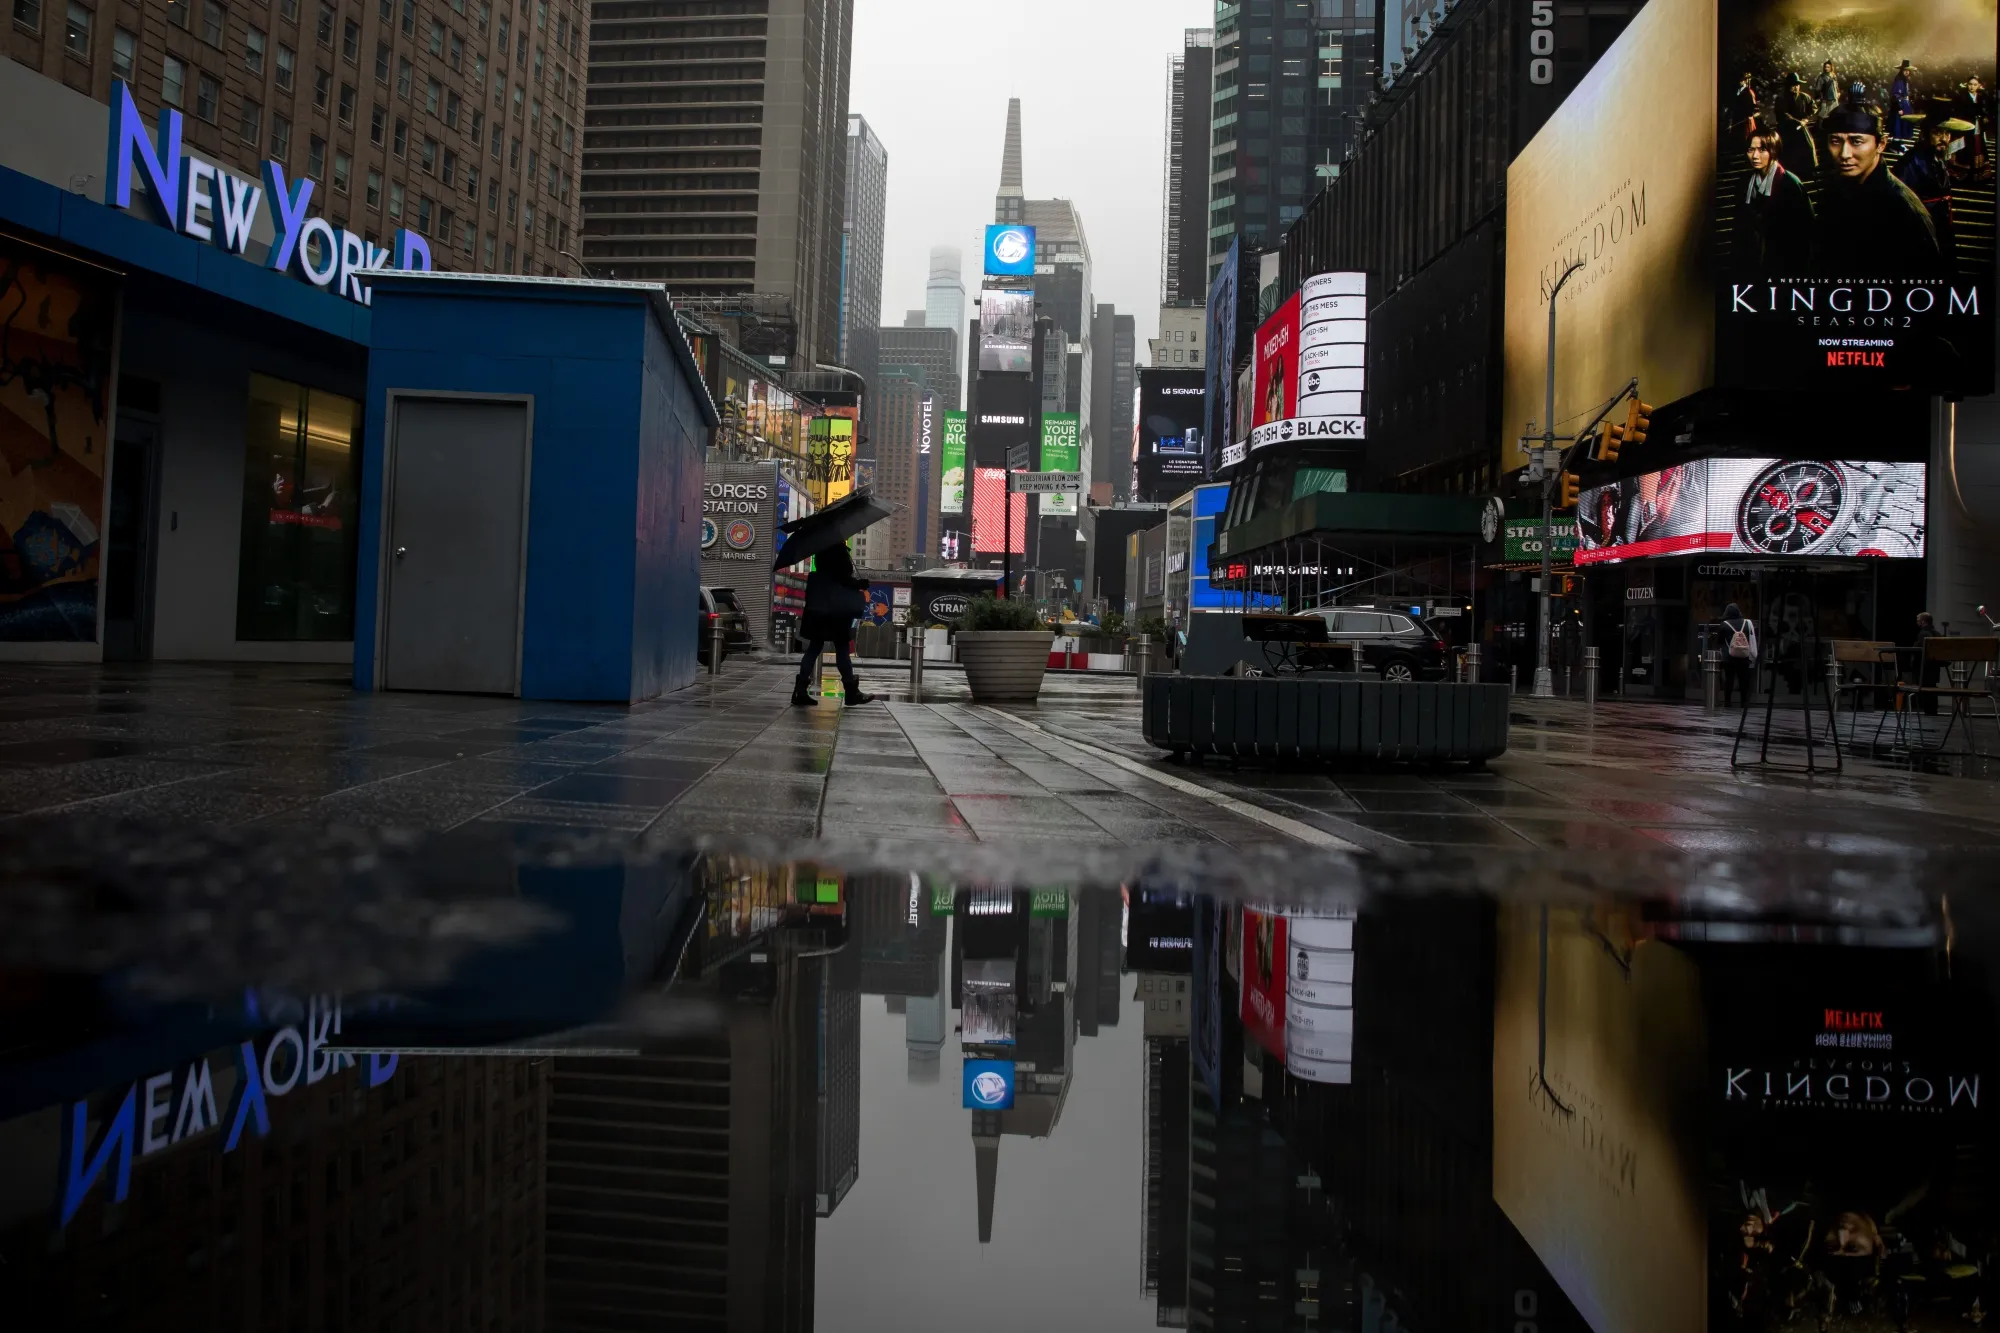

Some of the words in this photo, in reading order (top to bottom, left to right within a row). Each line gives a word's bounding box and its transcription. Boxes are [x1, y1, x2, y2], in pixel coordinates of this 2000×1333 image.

[1530, 1, 1554, 85] 500
[1540, 180, 1646, 305] KINGDOM
[1565, 265, 1605, 302] SEASON
[1319, 301, 1338, 309] MESS
[1732, 284, 1980, 316] KINGDOM
[1797, 316, 1894, 327] SEASON
[1902, 316, 1911, 328] 2
[1818, 338, 1841, 346] NOW
[1842, 338, 1894, 347] STREAMING
[1827, 350, 1885, 367] NETFLIX
[920, 397, 932, 454] NOVOTEL
[981, 415, 1024, 424] SAMSUNG
[1045, 426, 1076, 434] YOUR
[1253, 426, 1278, 446] ED-ISH
[1044, 435, 1076, 446] RICE
[1020, 474, 1051, 482] PEDESTRIAN
[1034, 483, 1054, 491] MOVING
[703, 500, 758, 513] STATION
[1506, 525, 1578, 538] STABUC
[723, 552, 756, 560] MARINES
[1697, 564, 1745, 577] CITIZEN
[1626, 587, 1653, 599] CITIZEN
